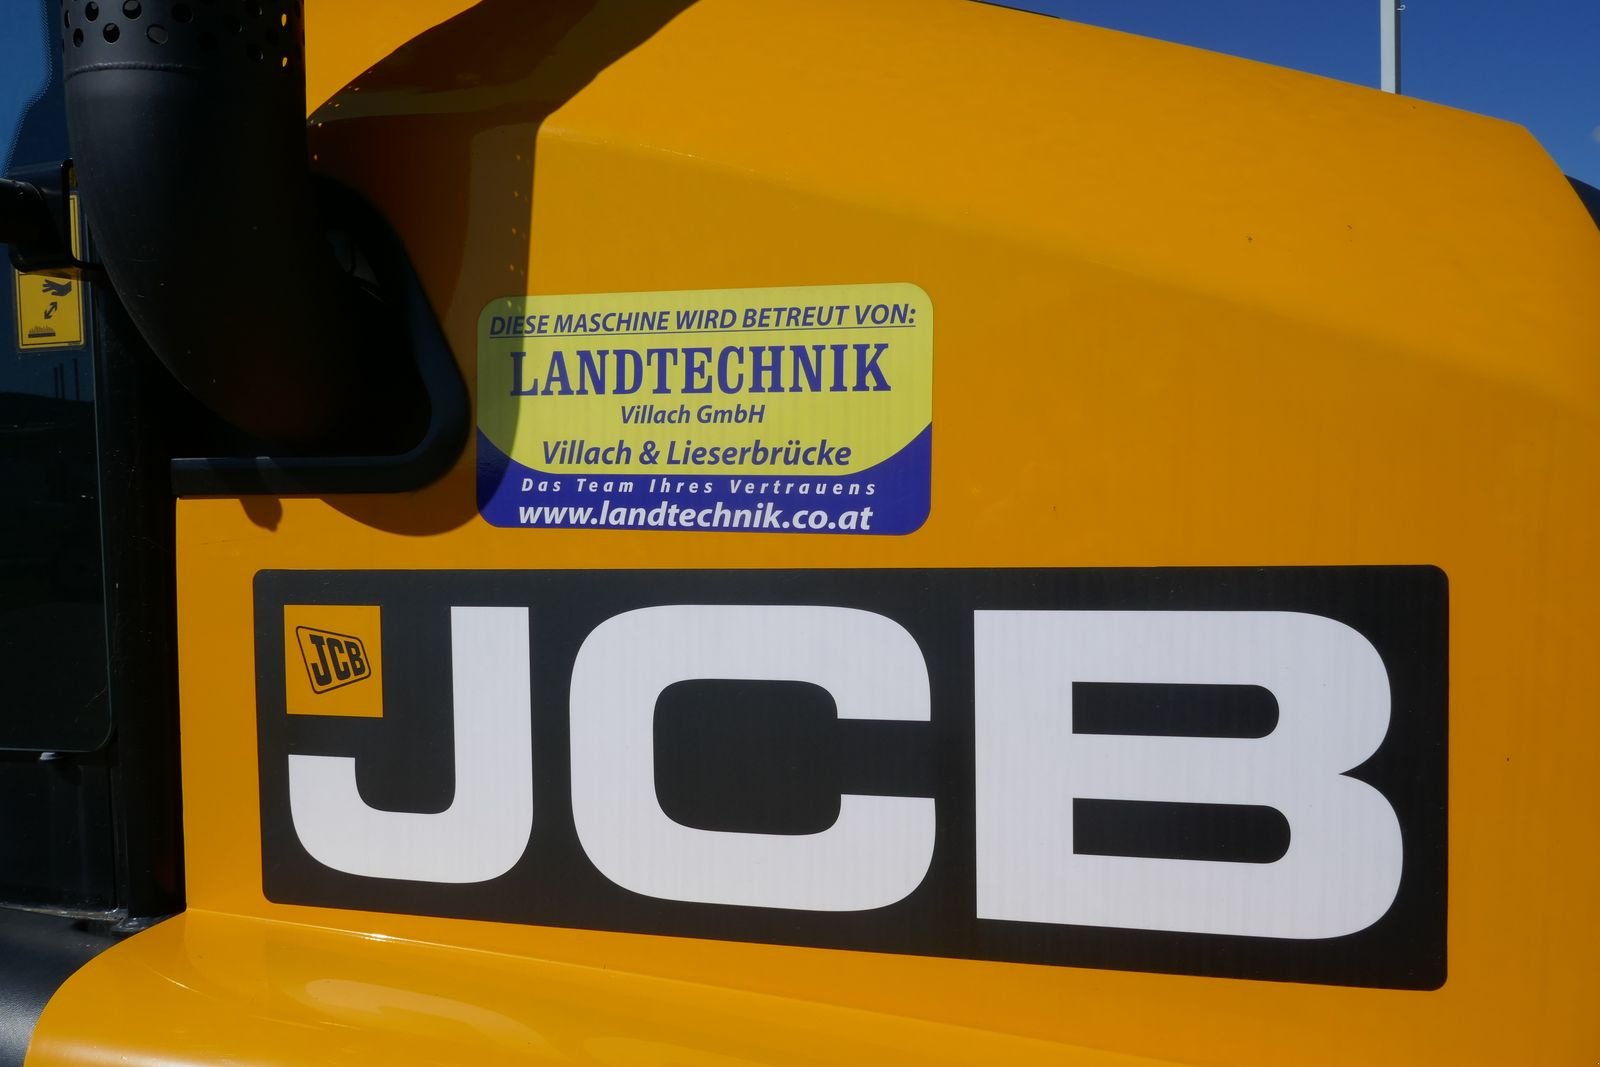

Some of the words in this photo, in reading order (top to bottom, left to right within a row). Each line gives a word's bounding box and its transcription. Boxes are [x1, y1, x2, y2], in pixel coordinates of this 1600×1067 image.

[490, 314, 550, 336] DIESE
[553, 310, 671, 334] MASCHINE
[675, 308, 737, 330] WIRD
[742, 305, 850, 328] BETREUT
[854, 303, 917, 325] VON:
[509, 343, 892, 396] LANDTECHNIK
[621, 404, 692, 424] Villach
[696, 404, 766, 424] GmbH
[542, 440, 632, 465] Villach
[639, 441, 660, 465] &
[667, 440, 852, 466] Lieserbrücke
[521, 478, 562, 493] Das
[576, 478, 634, 493] Team
[649, 478, 713, 494] Ihres
[730, 479, 876, 495] Vertrauens
[518, 500, 874, 531] www.landtechnik.co.at
[309, 634, 366, 687] JCB
[288, 604, 1404, 941] JCB
